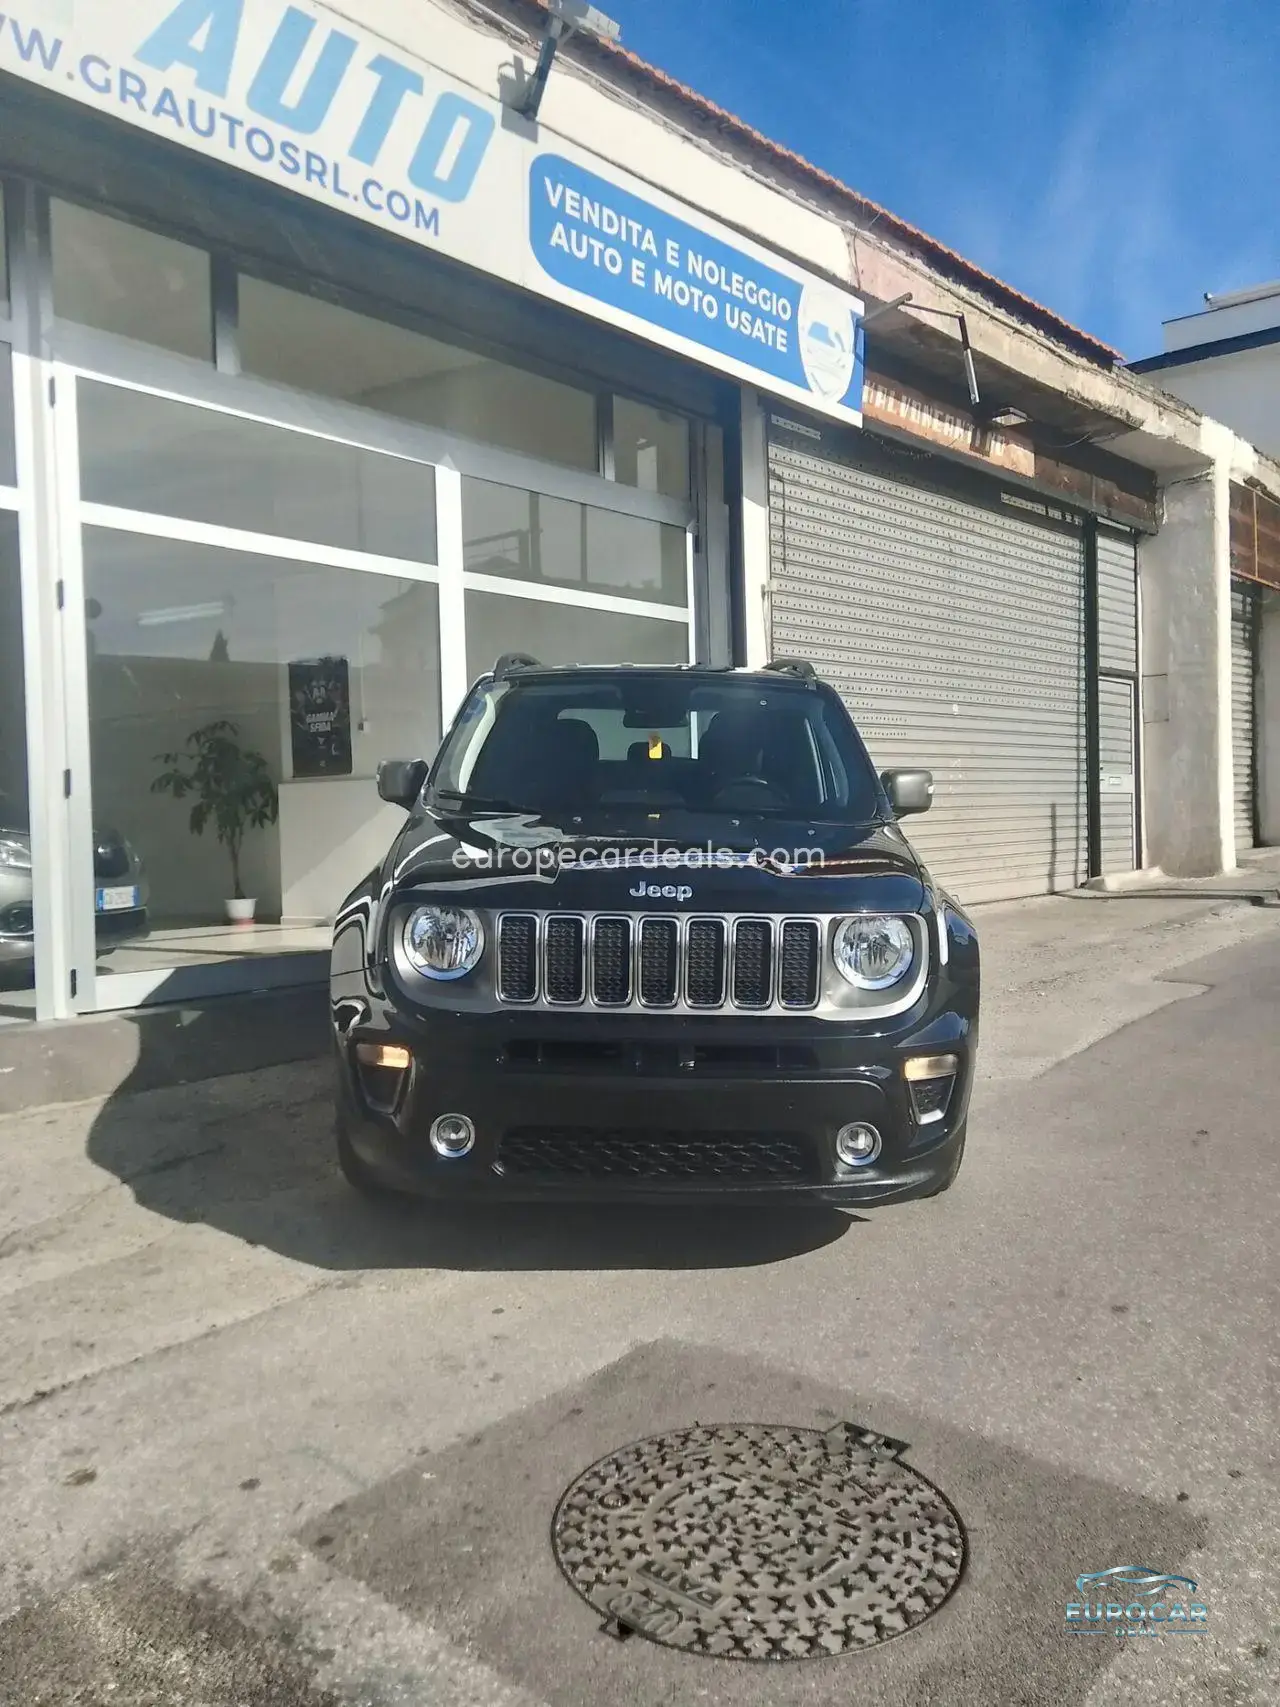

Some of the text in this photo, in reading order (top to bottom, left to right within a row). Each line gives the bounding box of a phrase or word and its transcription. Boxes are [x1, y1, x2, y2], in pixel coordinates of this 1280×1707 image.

[0, 12, 441, 237] W.GRAUTOSRL.COM
[133, 0, 496, 203] AUTO
[543, 176, 793, 322] VENDITA E NOLEGGIO
[550, 221, 788, 353] AUTO E MOTO USATE
[629, 880, 694, 902] Jeep
